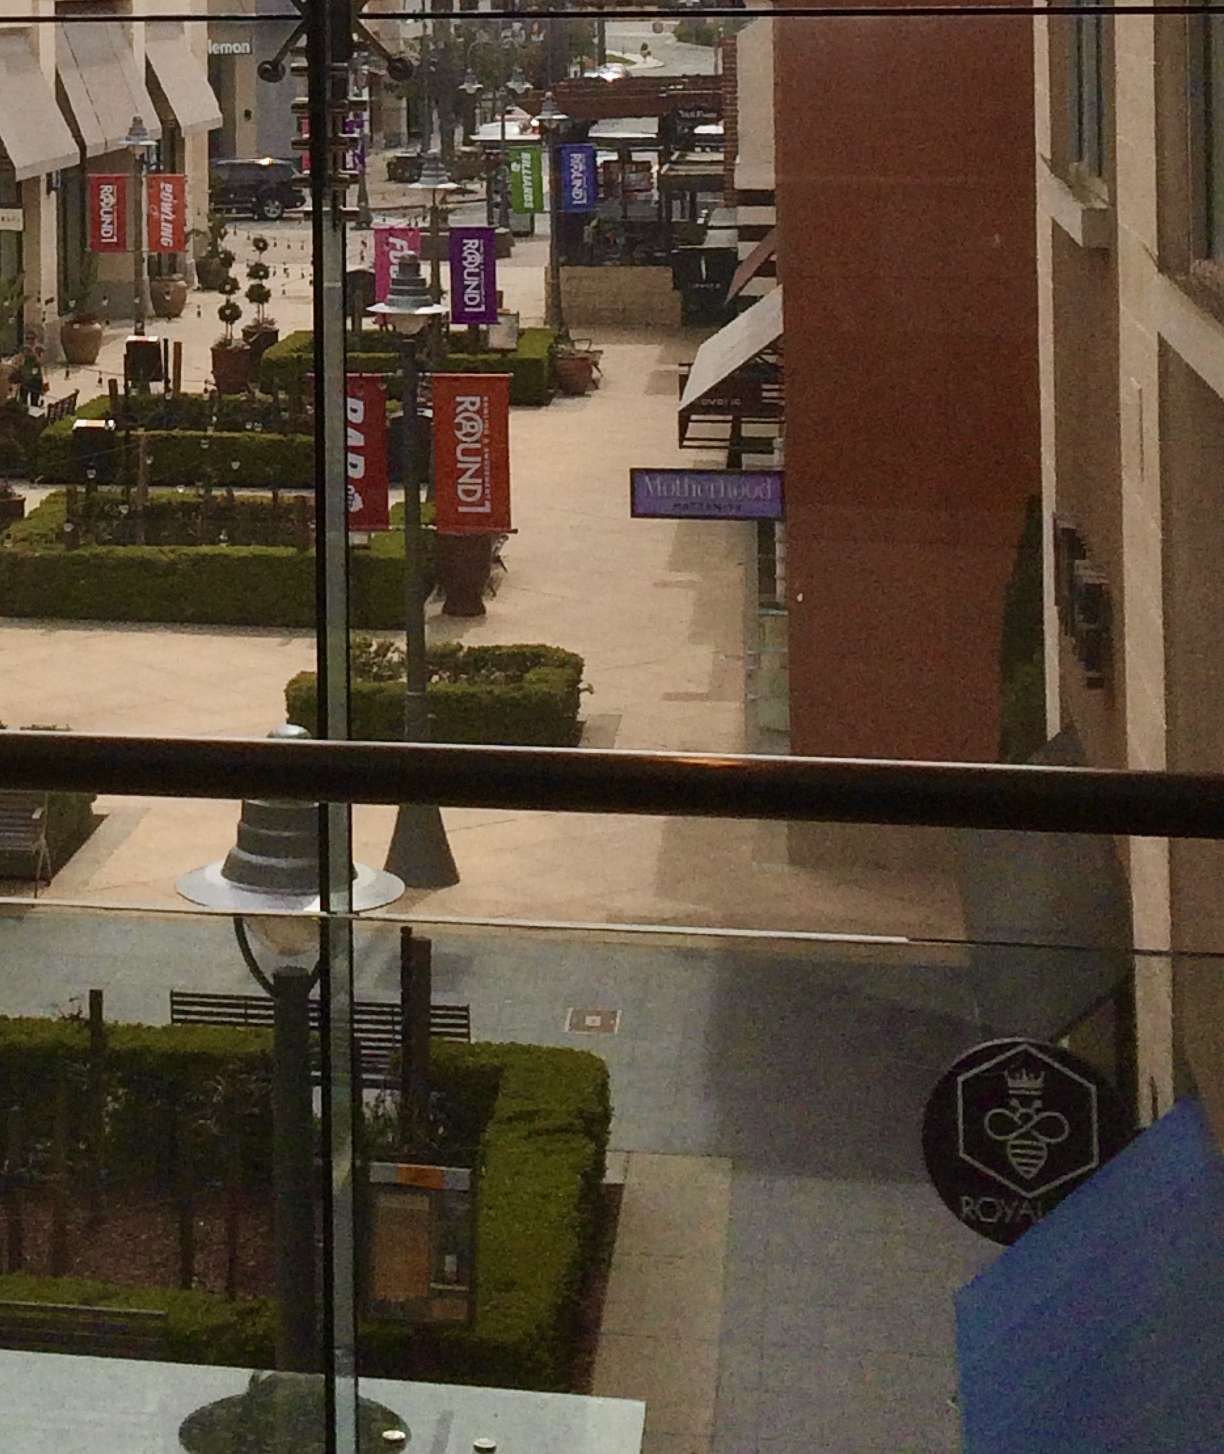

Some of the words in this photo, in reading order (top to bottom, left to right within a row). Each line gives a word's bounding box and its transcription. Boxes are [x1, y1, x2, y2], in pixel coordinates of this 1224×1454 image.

[159, 182, 174, 247] BOWLING
[462, 238, 486, 312] ROUND1
[454, 395, 491, 513] ROUND1
[643, 475, 773, 500] Motherhood
